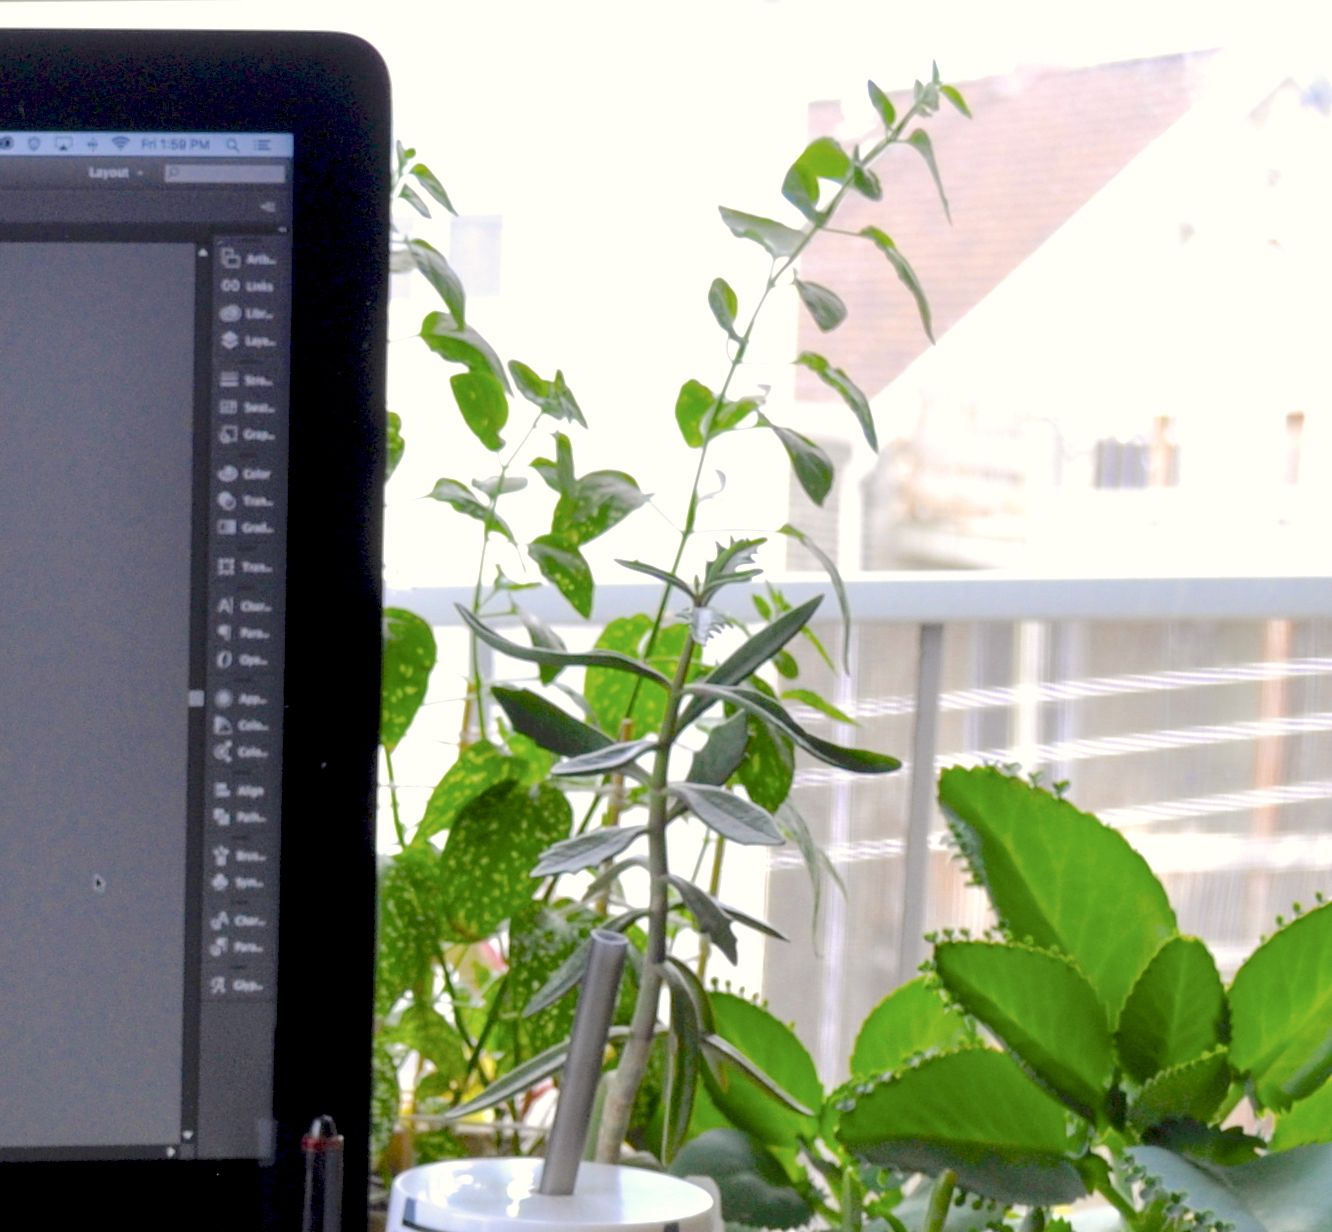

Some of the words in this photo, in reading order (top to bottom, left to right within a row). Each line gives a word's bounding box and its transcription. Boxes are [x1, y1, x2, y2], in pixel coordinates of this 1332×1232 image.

[141, 139, 157, 150] Fri
[190, 139, 210, 150] PM
[89, 167, 129, 180] Layout
